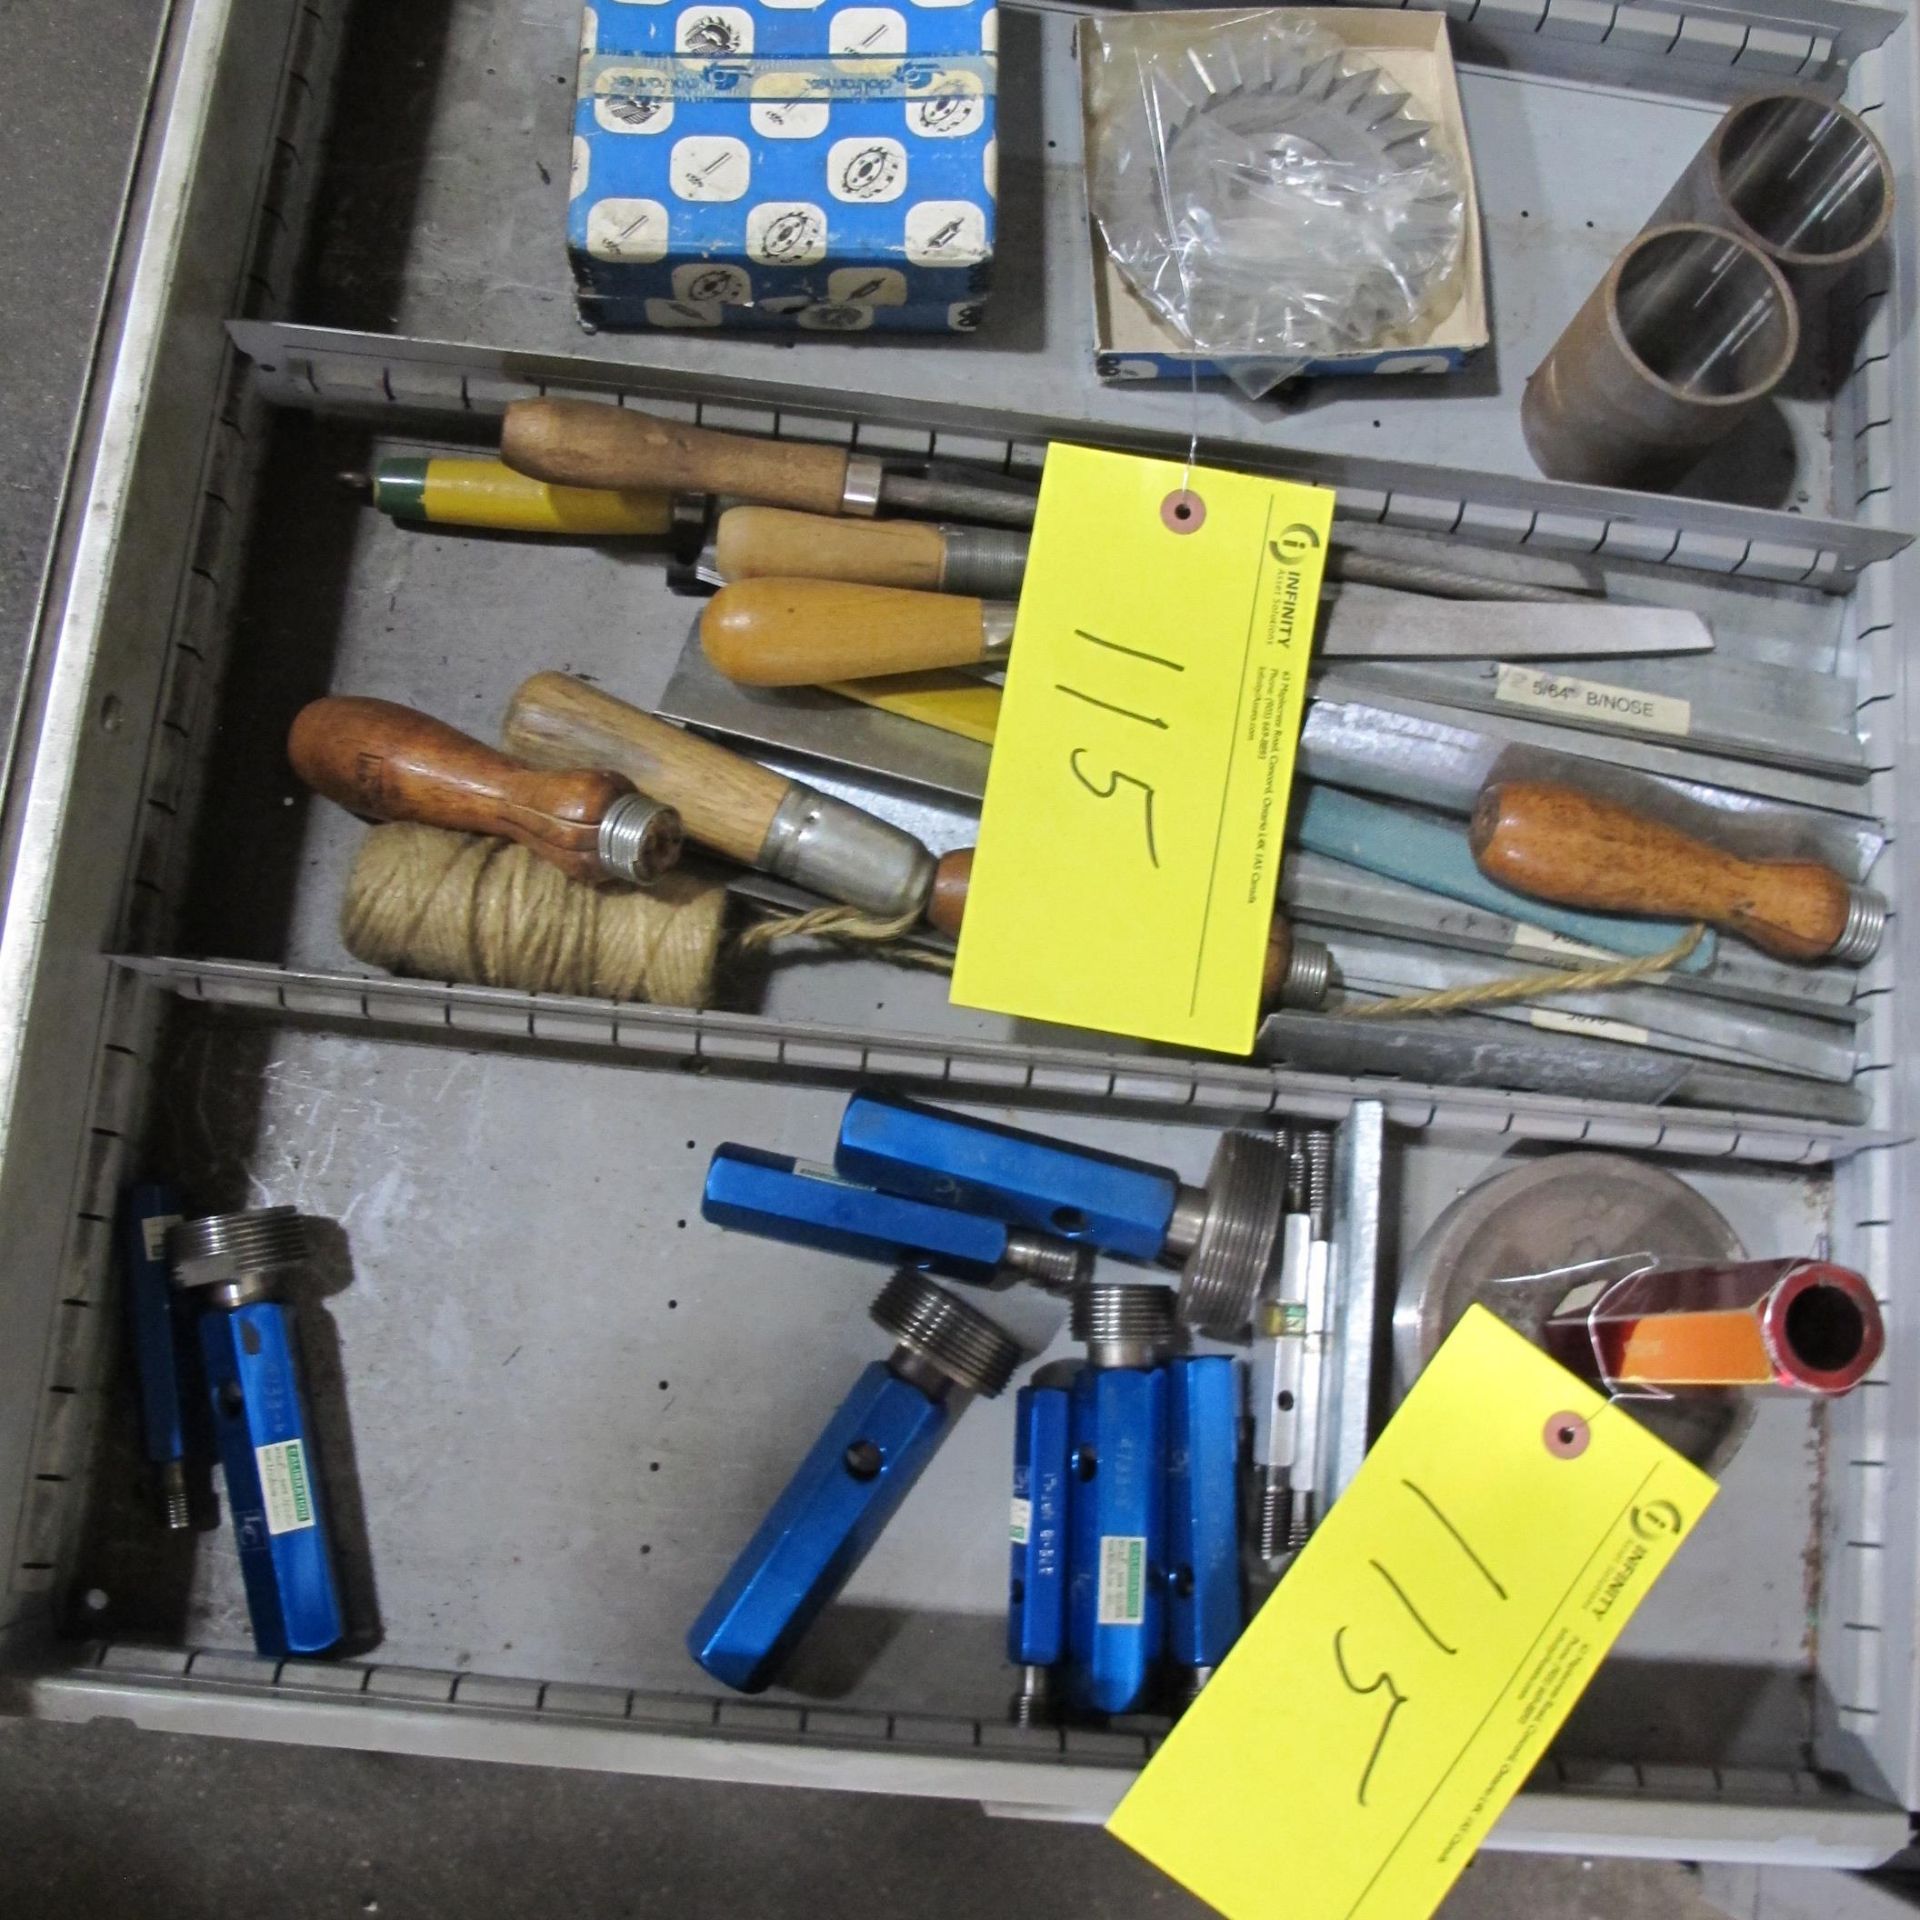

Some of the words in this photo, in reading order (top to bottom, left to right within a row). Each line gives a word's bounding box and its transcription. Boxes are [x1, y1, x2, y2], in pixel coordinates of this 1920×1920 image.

[1273, 568, 1285, 595] Asset
[1265, 598, 1280, 645] Solutions
[1276, 570, 1300, 648] INFINITY
[1586, 691, 1657, 717] B/NOSE
[1258, 797, 1272, 830] Ontario
[1589, 1541, 1648, 1623] INFINITY
